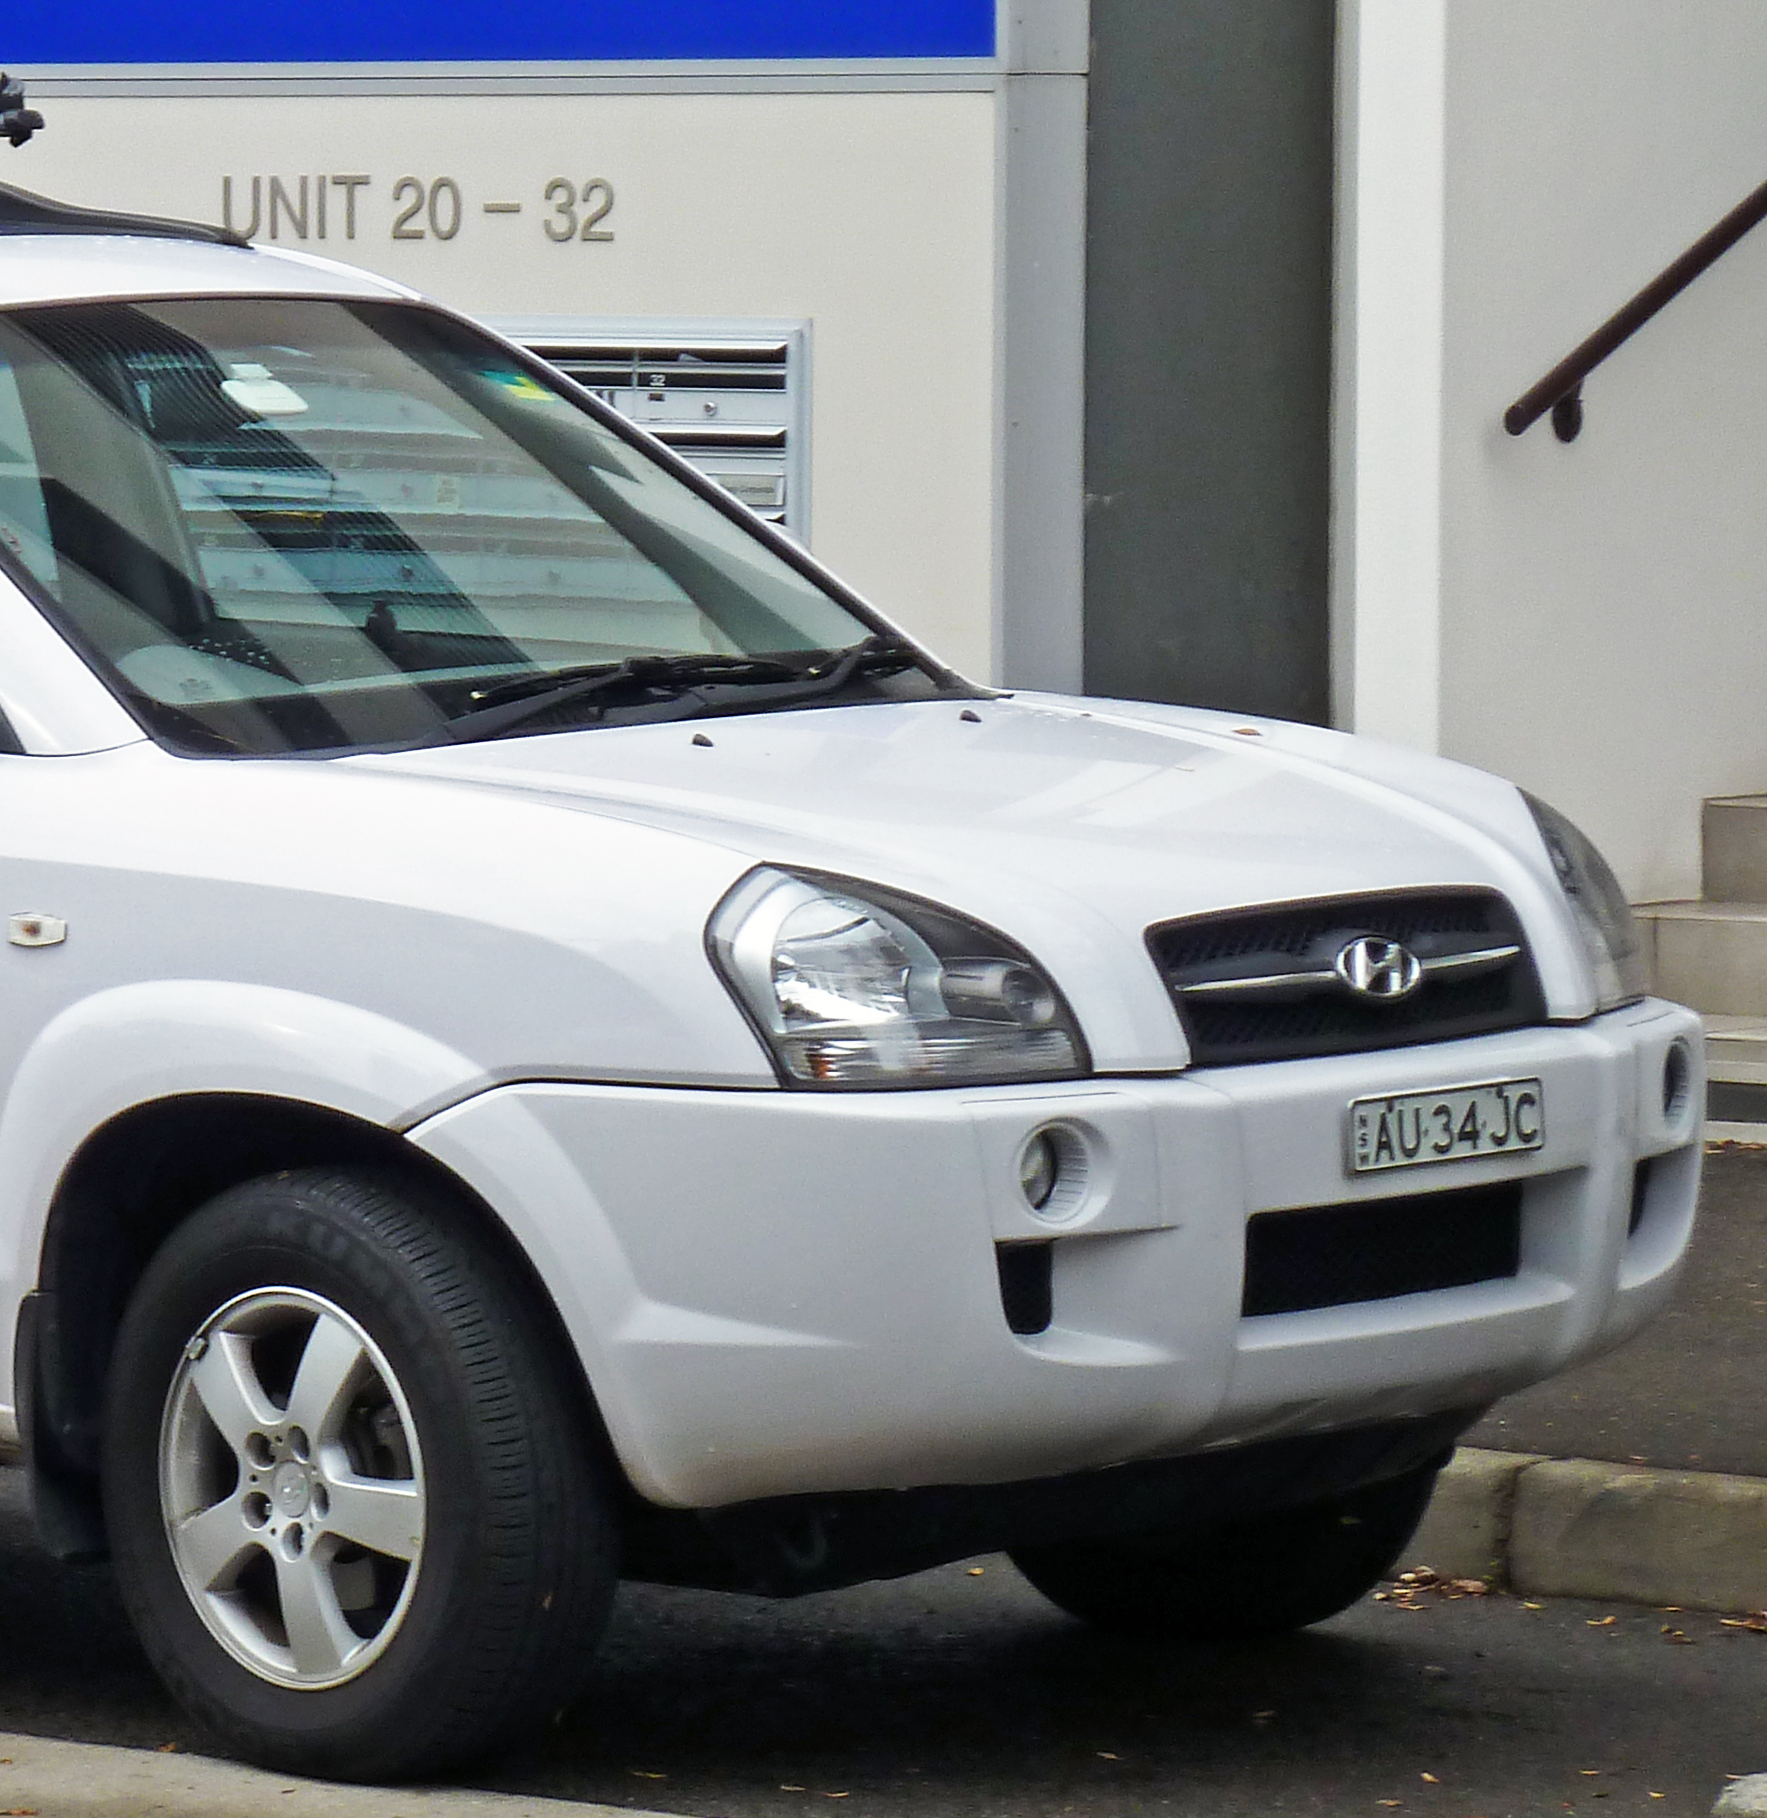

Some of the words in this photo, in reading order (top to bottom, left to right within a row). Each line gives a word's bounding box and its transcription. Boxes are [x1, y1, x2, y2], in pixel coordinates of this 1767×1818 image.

[221, 175, 371, 240] UNIT
[392, 175, 462, 241] 20
[544, 176, 615, 242] 32
